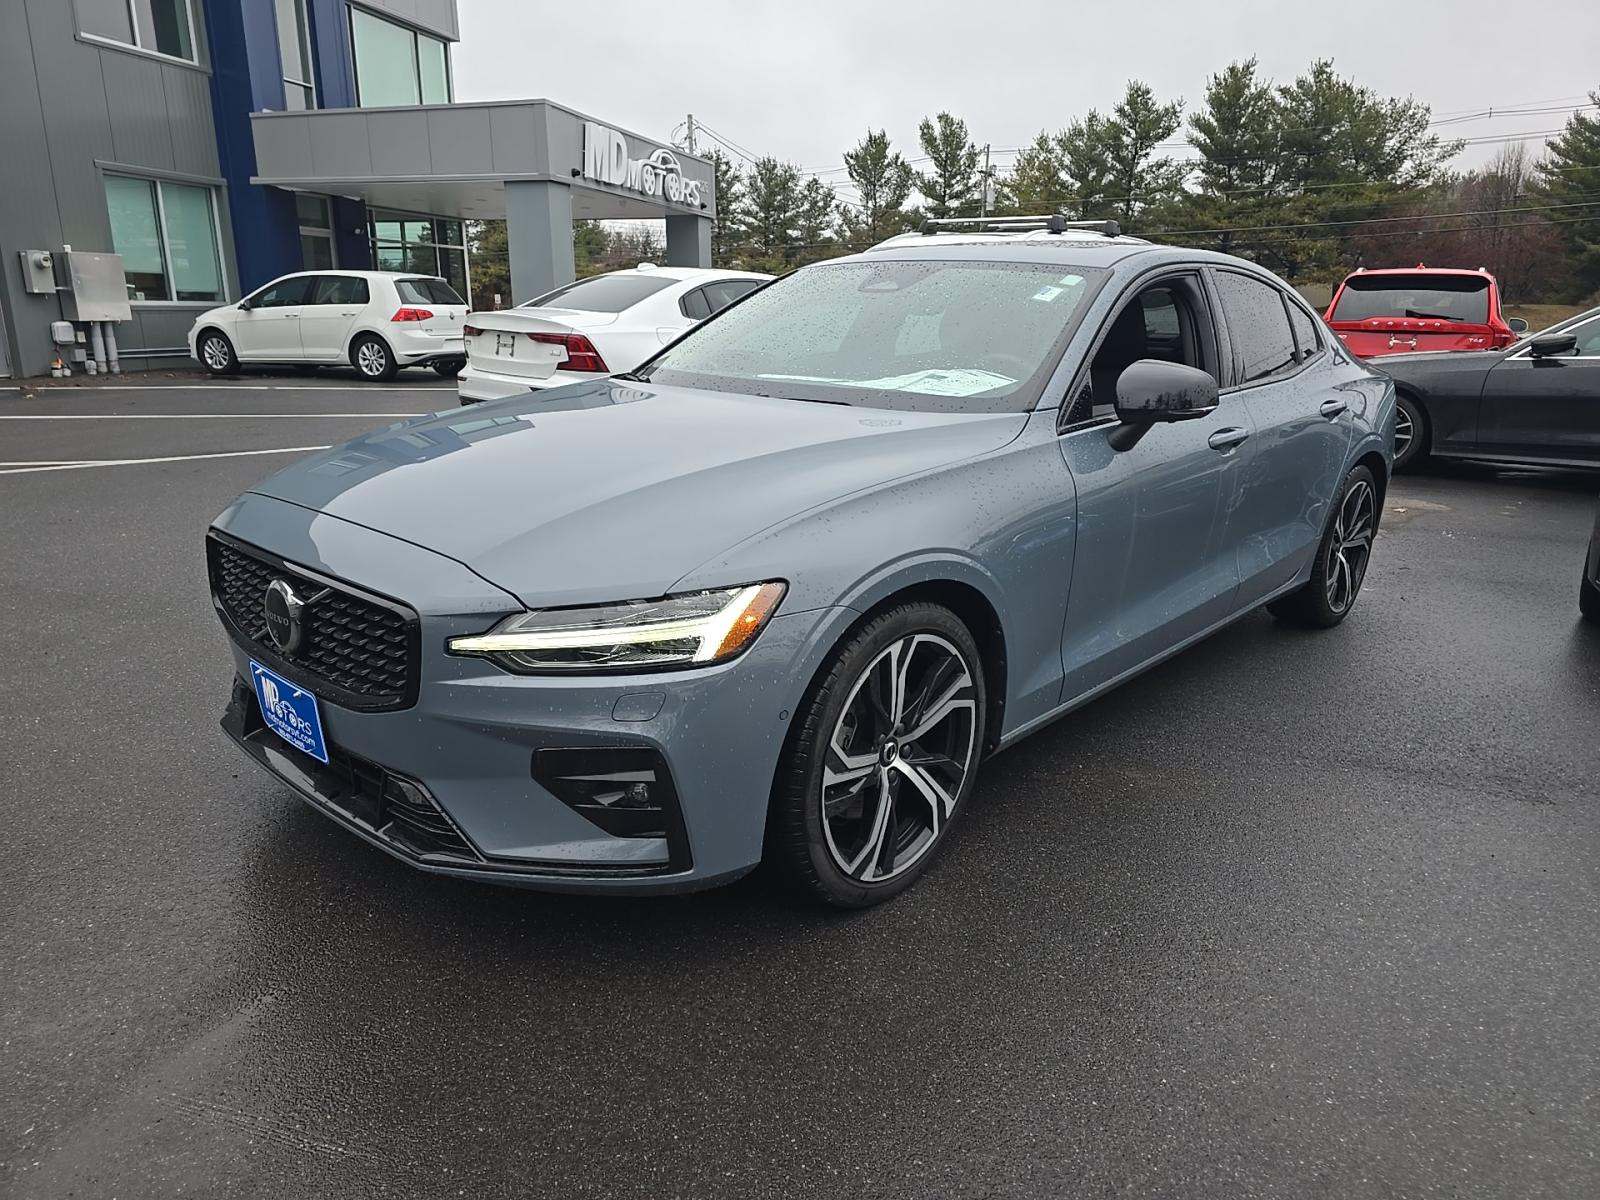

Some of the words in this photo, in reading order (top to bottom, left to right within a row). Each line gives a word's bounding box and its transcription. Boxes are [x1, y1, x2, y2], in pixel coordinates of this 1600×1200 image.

[584, 122, 628, 185] MD
[624, 157, 701, 206] MOTORS
[267, 611, 289, 626] VOLVO
